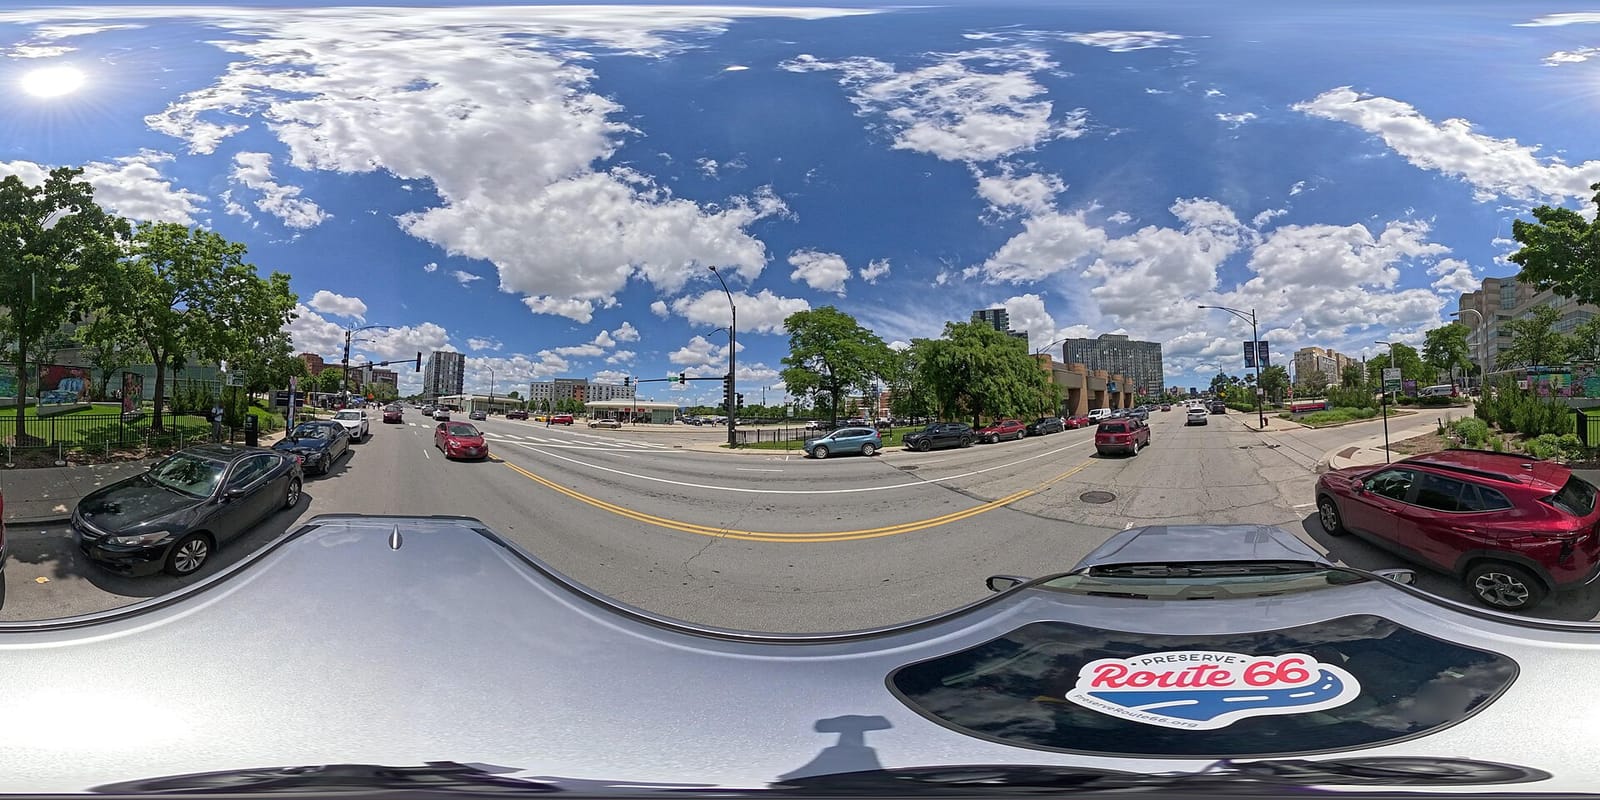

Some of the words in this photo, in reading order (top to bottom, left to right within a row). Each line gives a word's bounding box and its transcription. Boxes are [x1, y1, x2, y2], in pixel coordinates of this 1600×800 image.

[1091, 663, 1236, 688] Route
[1243, 658, 1310, 687] 66
[1141, 653, 1237, 666] PRESERVE
[1074, 694, 1199, 728] PreserveRoute66.org
